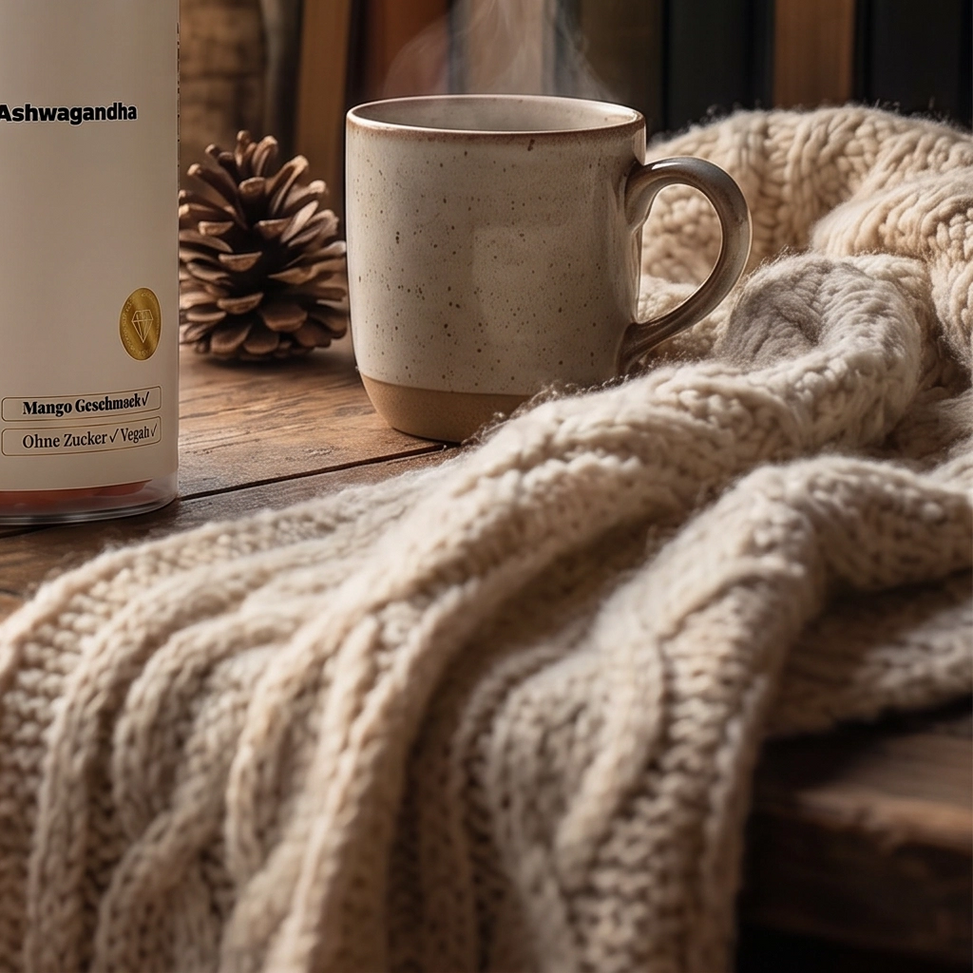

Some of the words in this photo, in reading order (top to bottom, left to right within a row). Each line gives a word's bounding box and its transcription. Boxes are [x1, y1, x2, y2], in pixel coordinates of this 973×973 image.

[22, 400, 73, 418] Mango
[22, 433, 61, 449] Ohne
[63, 431, 108, 448] Zucker
